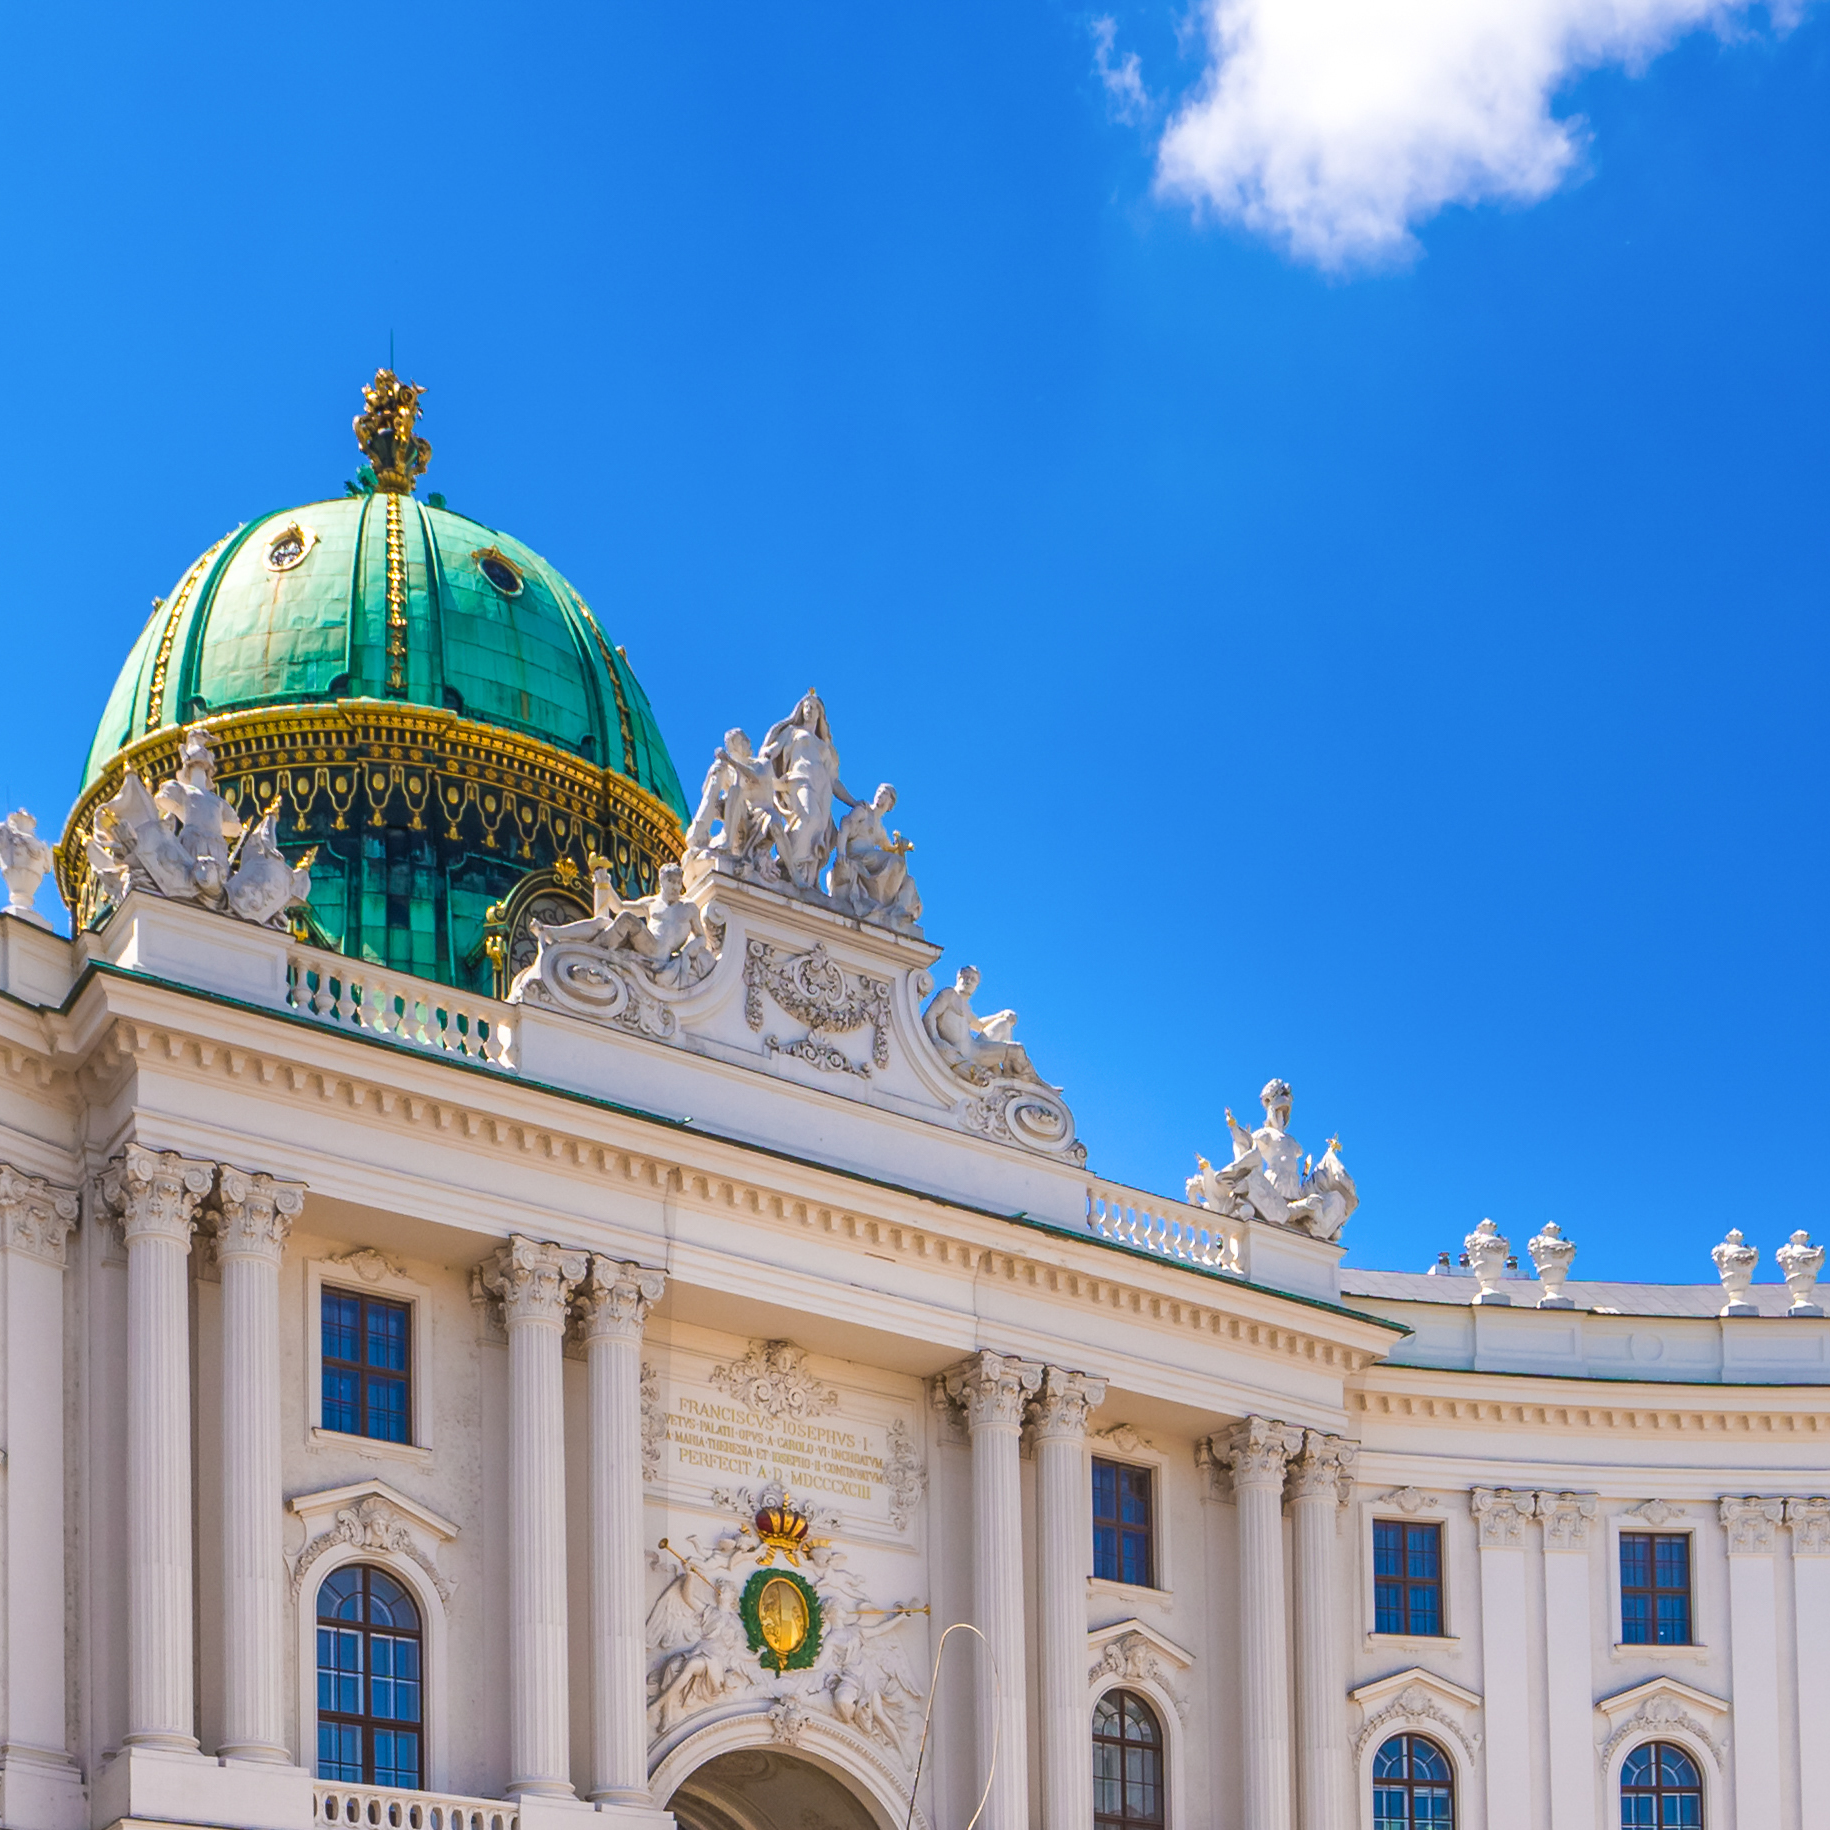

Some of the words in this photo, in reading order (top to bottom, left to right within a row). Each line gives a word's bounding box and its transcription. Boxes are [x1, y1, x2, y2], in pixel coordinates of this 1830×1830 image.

[663, 1412, 696, 1430] VETVS
[738, 1428, 765, 1444] OPVS
[777, 1437, 814, 1455] CAROLO
[679, 1397, 775, 1431] FRANCISCVS
[782, 1420, 856, 1448] IOSEPHVS
[679, 1447, 752, 1476] PERFECIT
[791, 1470, 871, 1500] MDCCCXCIII
[756, 1447, 769, 1460] ET
